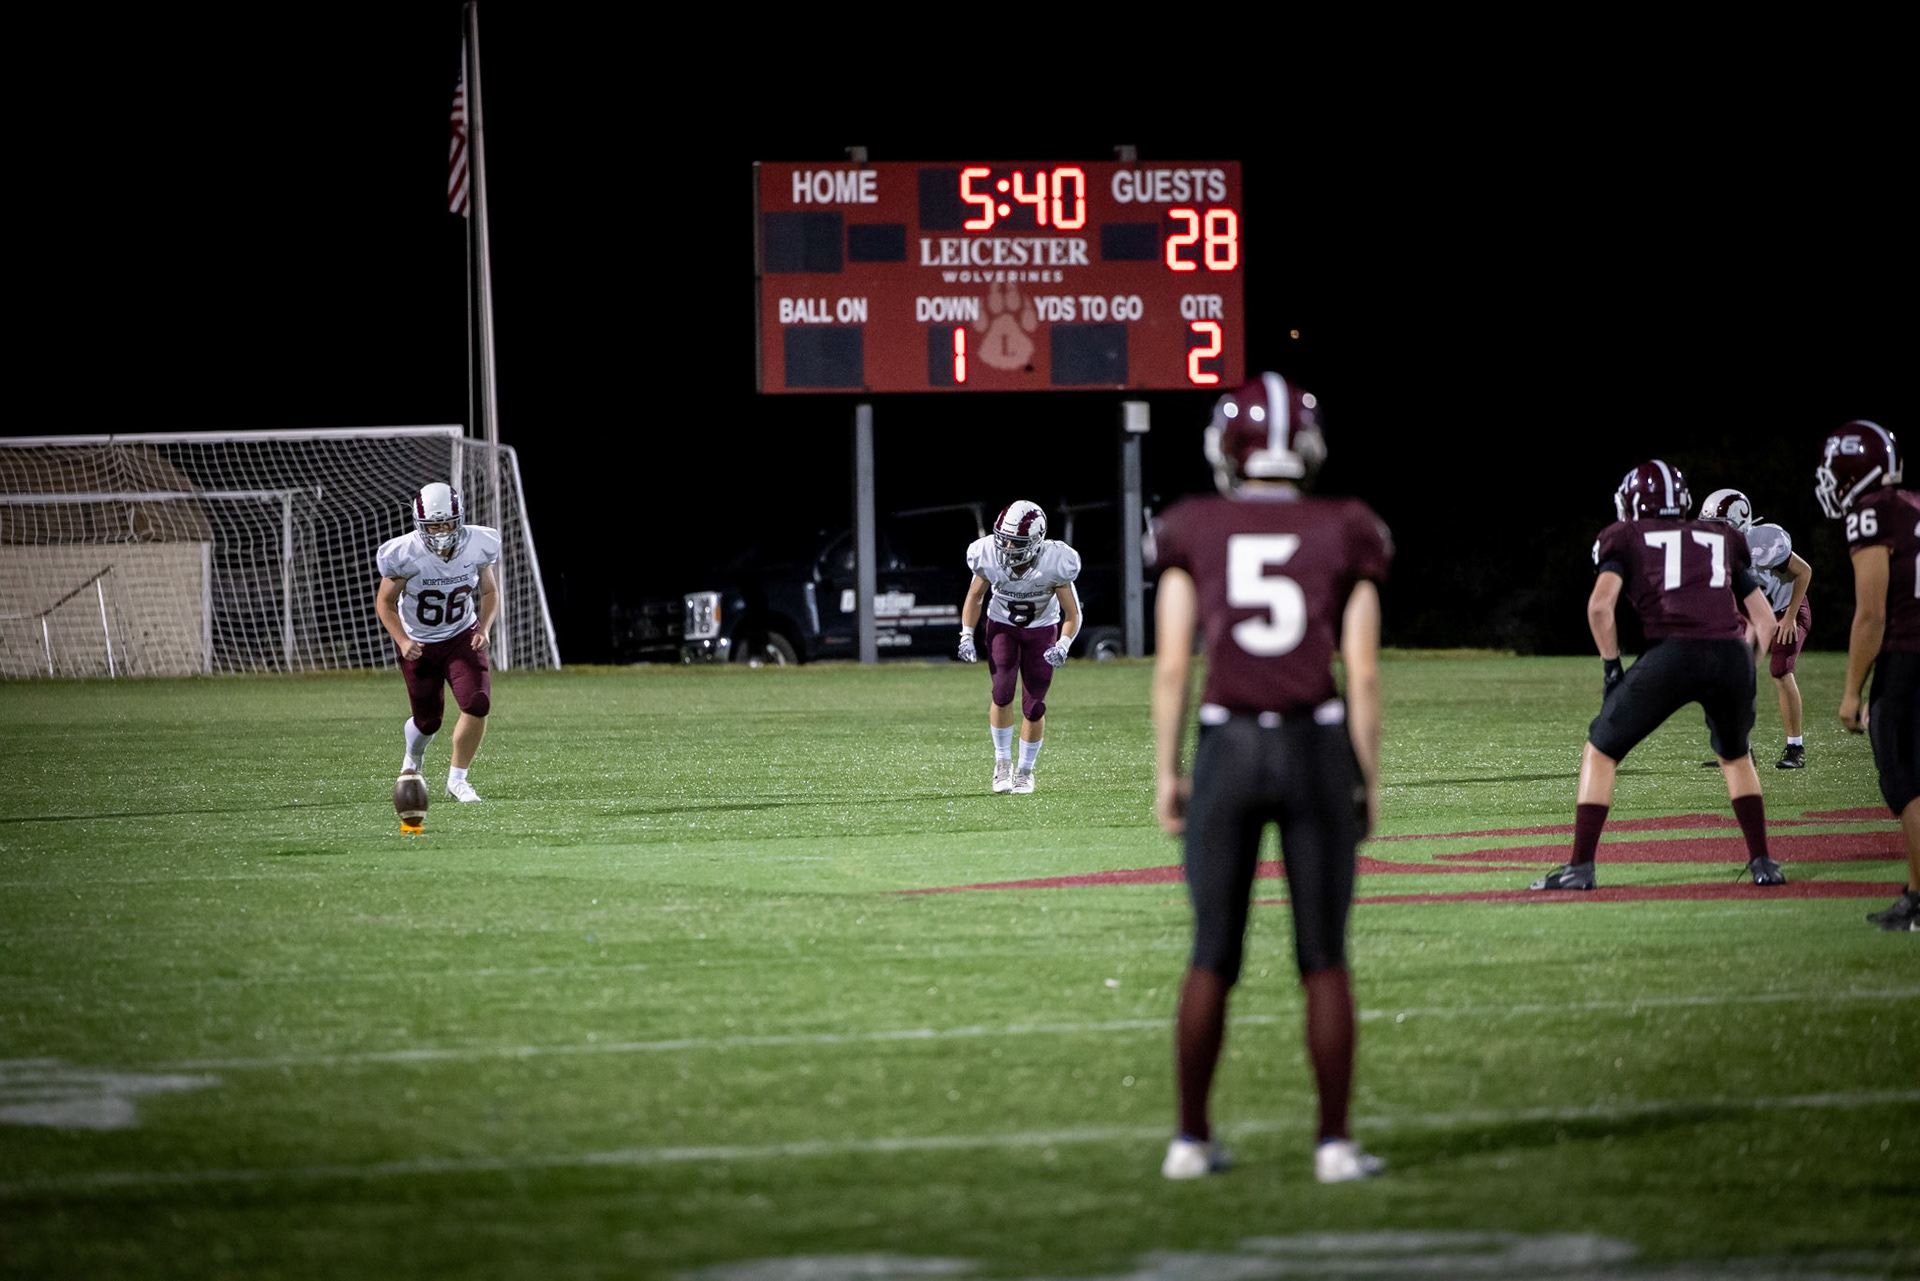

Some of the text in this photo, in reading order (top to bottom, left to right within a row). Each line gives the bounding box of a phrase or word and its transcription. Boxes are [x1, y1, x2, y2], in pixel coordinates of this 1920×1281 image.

[792, 170, 878, 204] HOME
[958, 166, 1087, 231] 5:40
[1111, 169, 1226, 203] GUESTS
[919, 237, 1090, 266] LEICESTER
[1164, 207, 1239, 272] 28
[941, 270, 1064, 284] WOLVERINES
[778, 297, 868, 324] BALL ON
[916, 296, 980, 322] DOWN
[1034, 295, 1143, 321] YDS TO GO
[1180, 294, 1223, 321] QTR
[952, 325, 968, 385] 1
[1187, 319, 1223, 385] 2
[1845, 508, 1878, 542] 26
[1643, 529, 1726, 591] 77
[416, 584, 474, 627] 66
[1226, 532, 1308, 657] 5
[1007, 600, 1036, 627] 8
